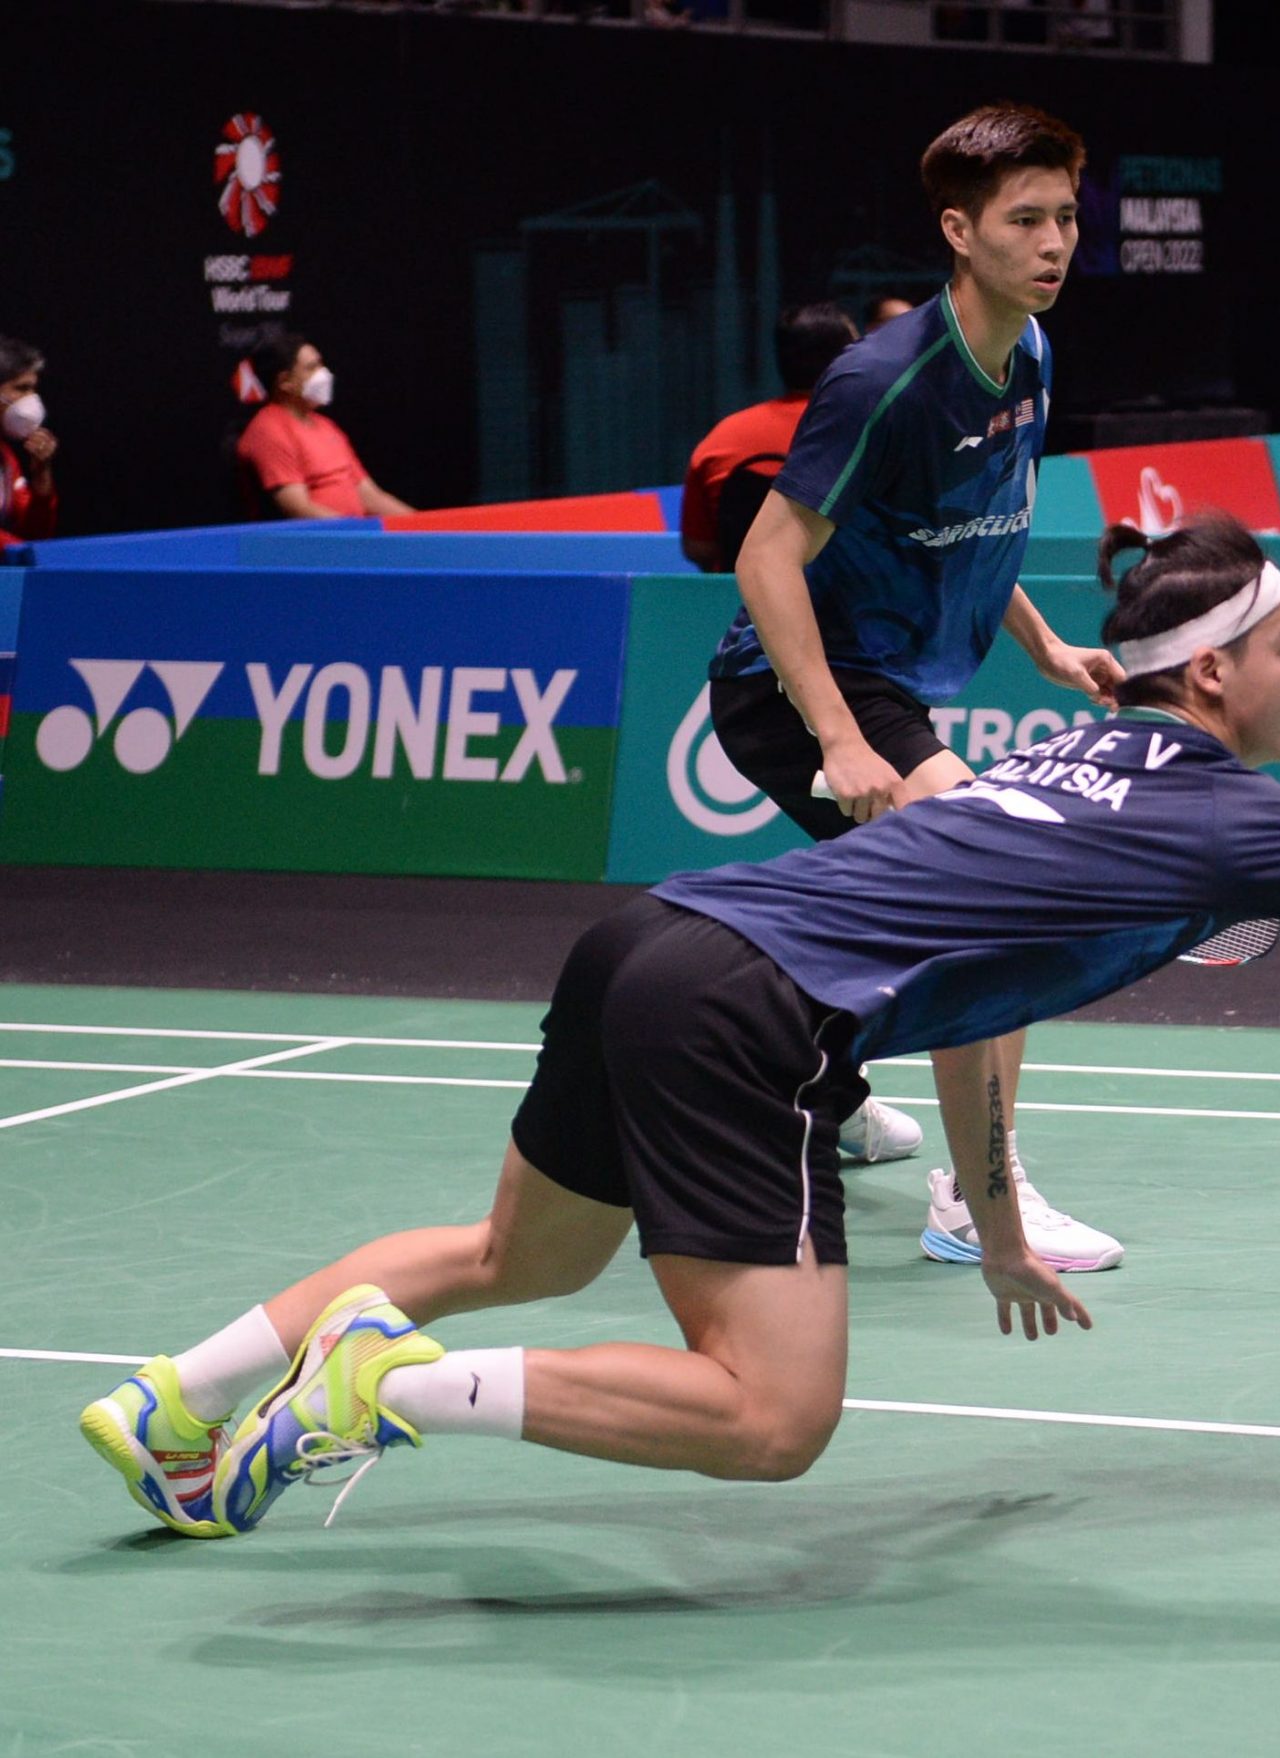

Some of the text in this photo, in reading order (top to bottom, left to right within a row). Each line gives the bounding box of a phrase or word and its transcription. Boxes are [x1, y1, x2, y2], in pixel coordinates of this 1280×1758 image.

[1120, 198, 1202, 233] MALAYSIA
[1120, 239, 1203, 273] OPEN 2022
[246, 661, 578, 784] YONEX
